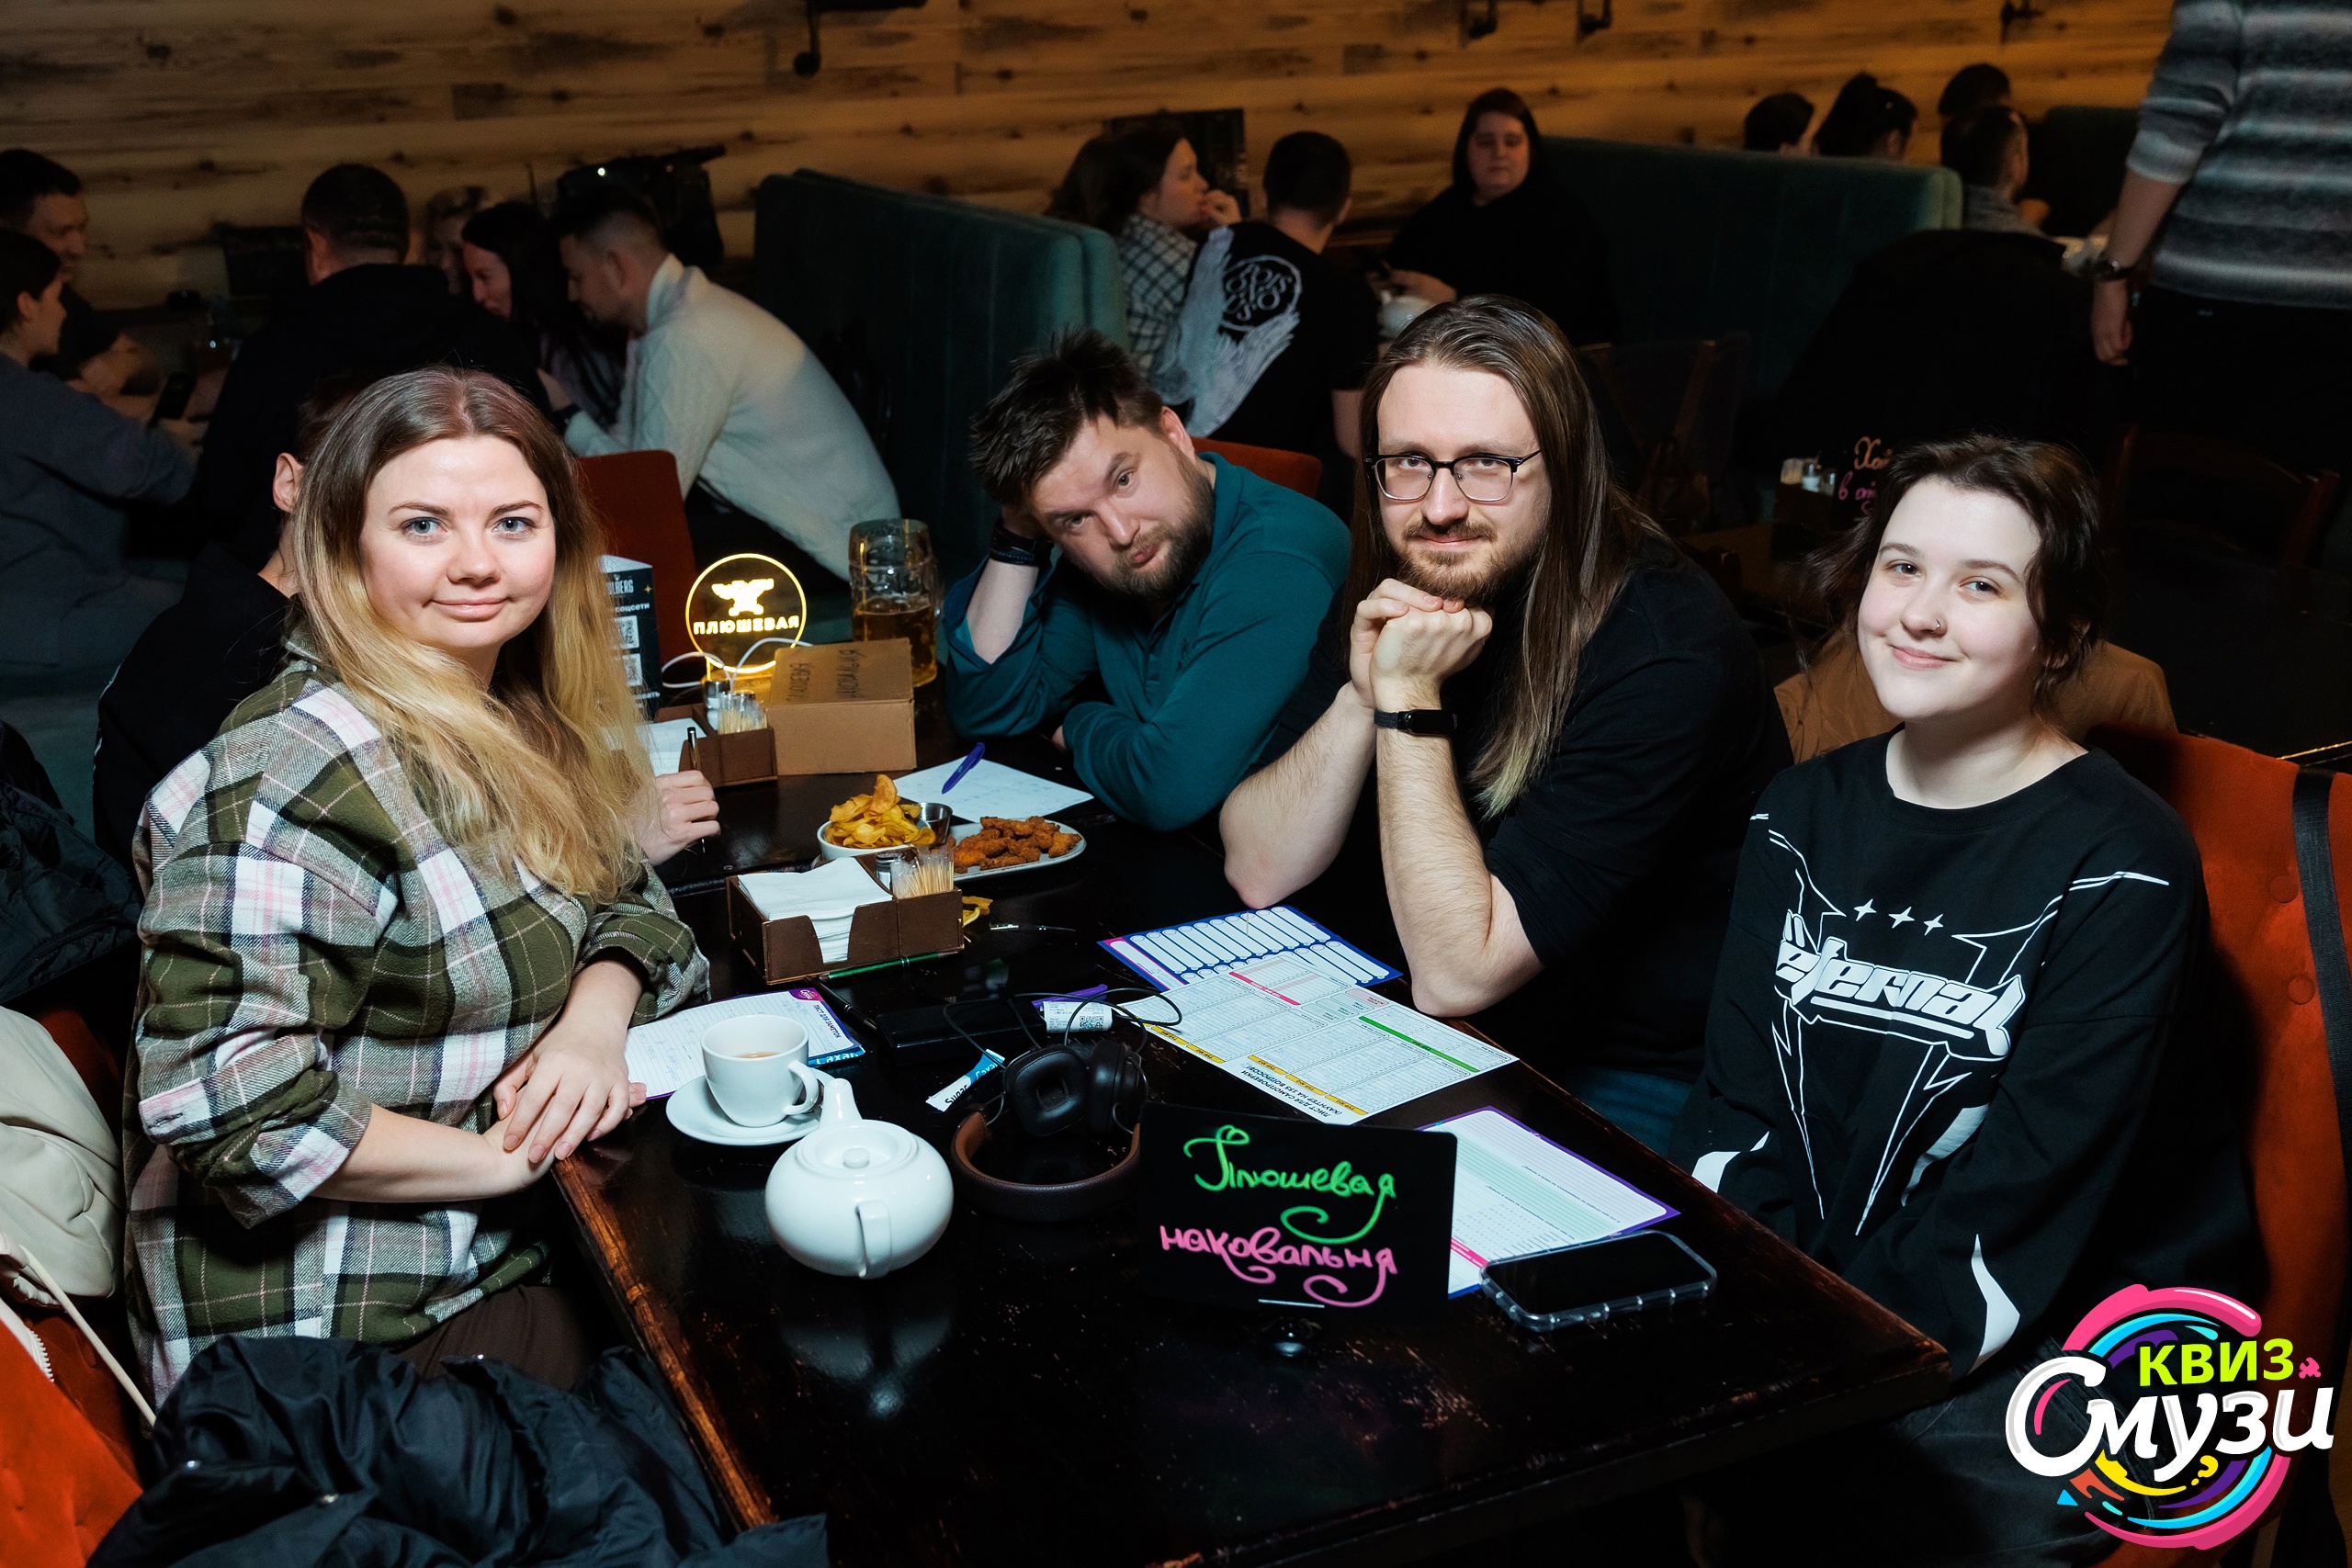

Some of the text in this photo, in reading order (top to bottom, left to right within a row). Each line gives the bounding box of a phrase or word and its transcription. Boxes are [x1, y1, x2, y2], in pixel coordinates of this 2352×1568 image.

[693, 615, 800, 636] ПЛЮШЕВАЯ
[1775, 935, 2025, 1057] eternal
[1183, 1124, 1396, 1245] Плюшевая
[1159, 1224, 1399, 1308] наковальня
